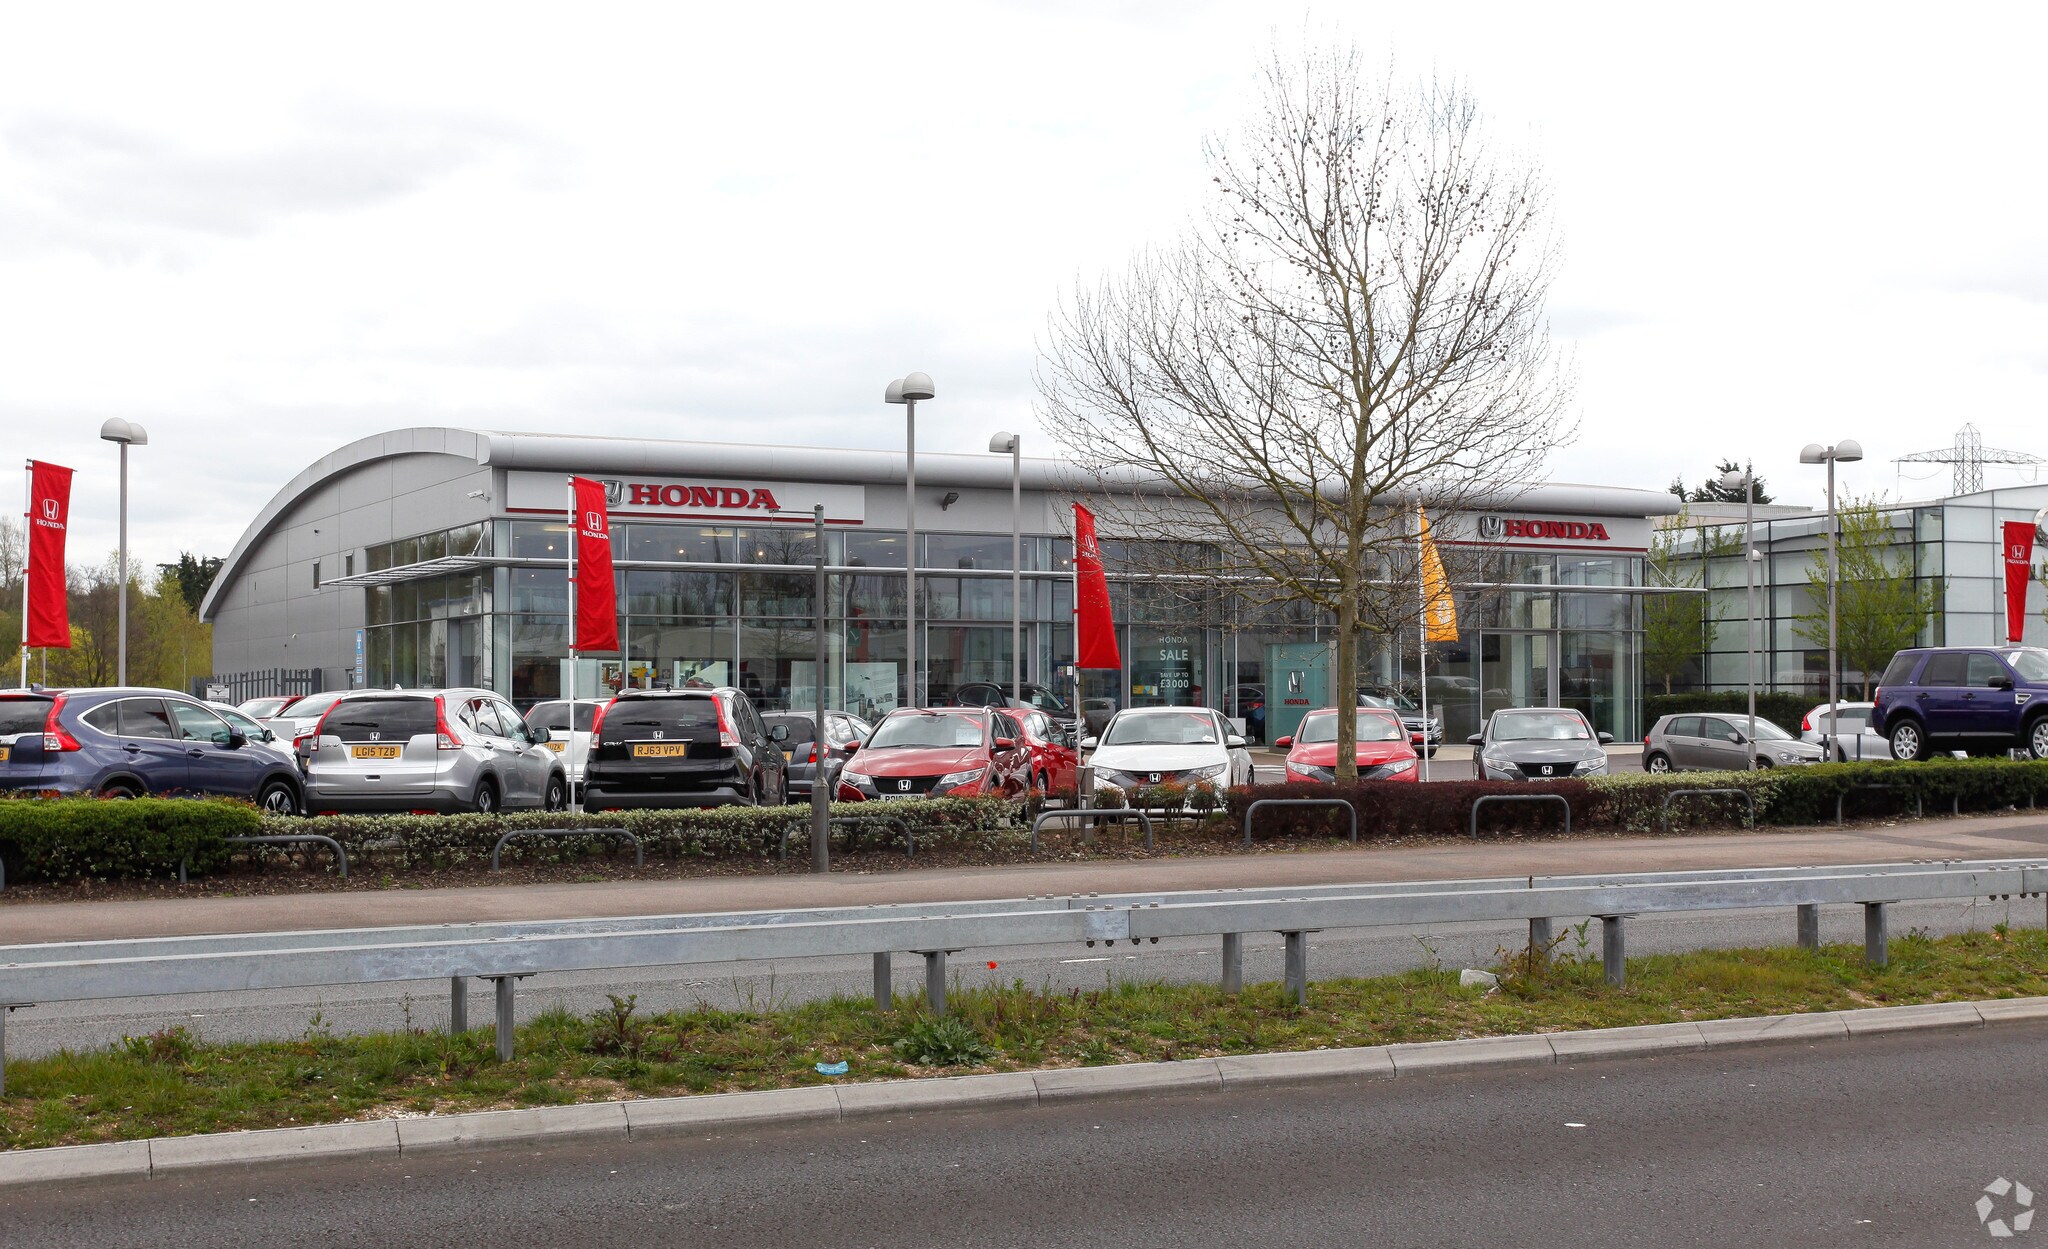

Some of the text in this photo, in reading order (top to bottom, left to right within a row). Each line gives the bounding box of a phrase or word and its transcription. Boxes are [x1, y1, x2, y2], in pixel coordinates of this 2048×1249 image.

[628, 483, 781, 509] HONDA
[36, 518, 65, 529] HONDA
[582, 529, 609, 539] HONDA
[1504, 519, 1610, 540] HONDA
[1160, 636, 1188, 644] HONDA
[1160, 649, 1189, 661] SALE
[1173, 671, 1181, 679] UP
[1181, 671, 1189, 679] TO
[355, 747, 395, 757] LG15 TZB
[637, 745, 681, 755] RJ63 VPV
